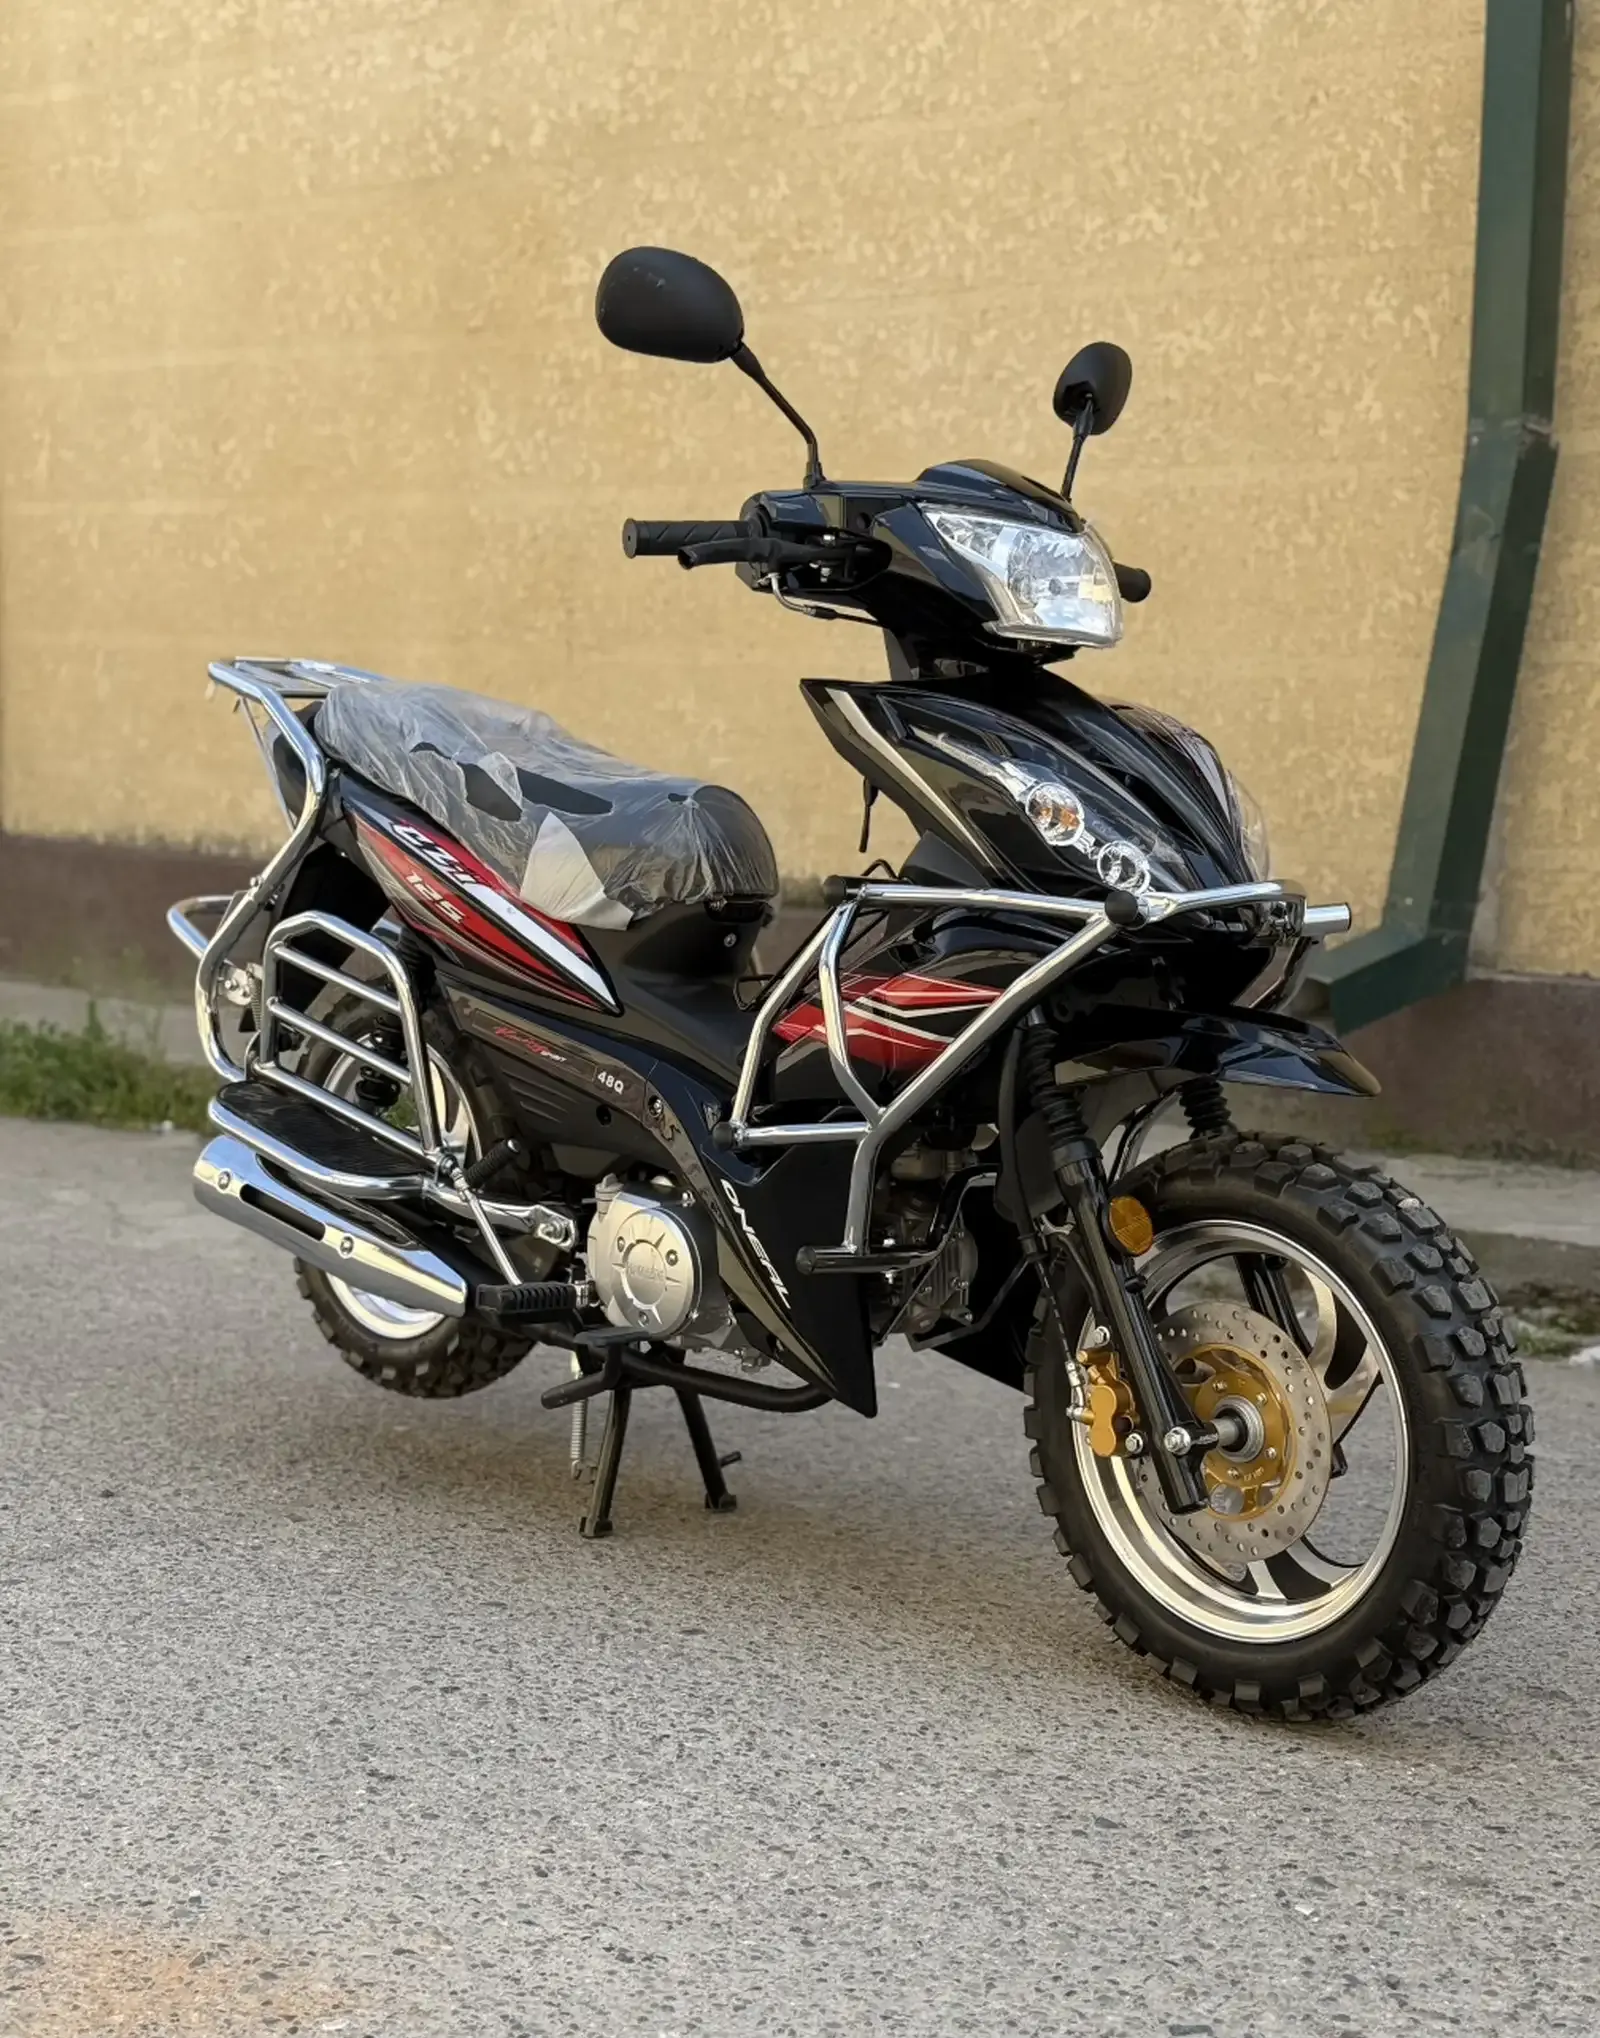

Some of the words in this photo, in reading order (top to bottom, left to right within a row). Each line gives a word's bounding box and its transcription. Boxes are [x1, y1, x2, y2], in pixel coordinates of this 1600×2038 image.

[405, 870, 466, 924] 125
[597, 1071, 624, 1095] 48Q
[720, 1178, 791, 1309] ONEAL
